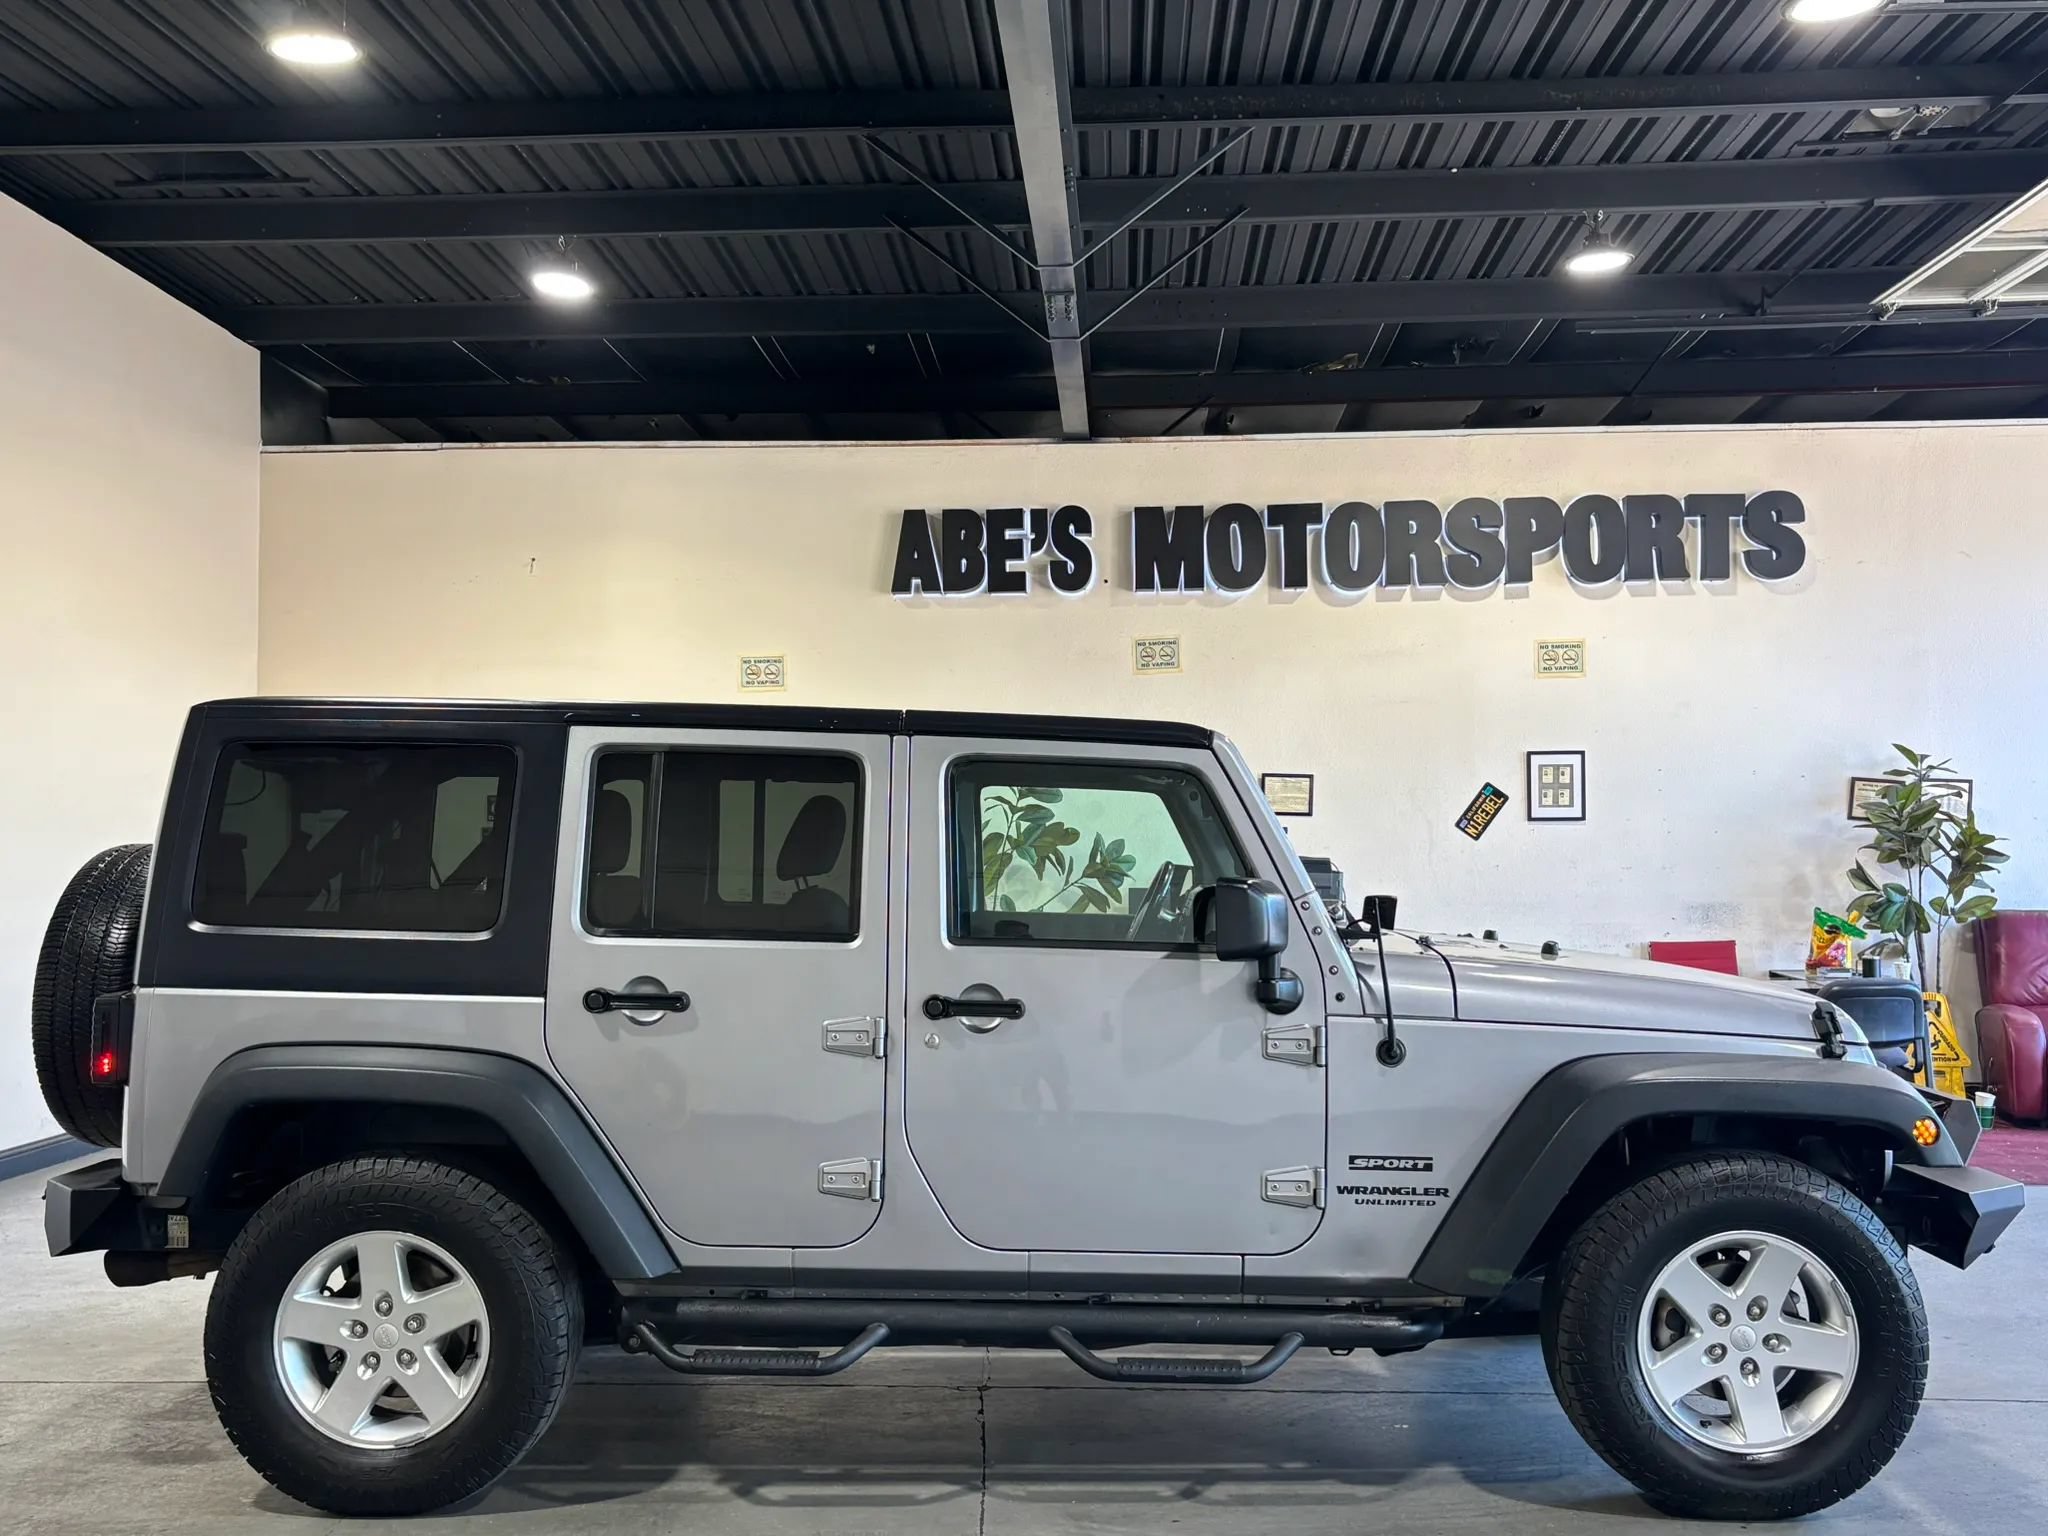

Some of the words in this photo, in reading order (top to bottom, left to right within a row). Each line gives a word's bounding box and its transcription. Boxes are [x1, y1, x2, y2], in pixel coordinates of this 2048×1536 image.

[891, 505, 1093, 594] ABE'S
[1133, 490, 1806, 592] MOTORSPORTS
[1349, 1157, 1432, 1170] SPORT
[1336, 1185, 1450, 1198] WRANGLER
[1354, 1198, 1436, 1207] UNLIMITED
